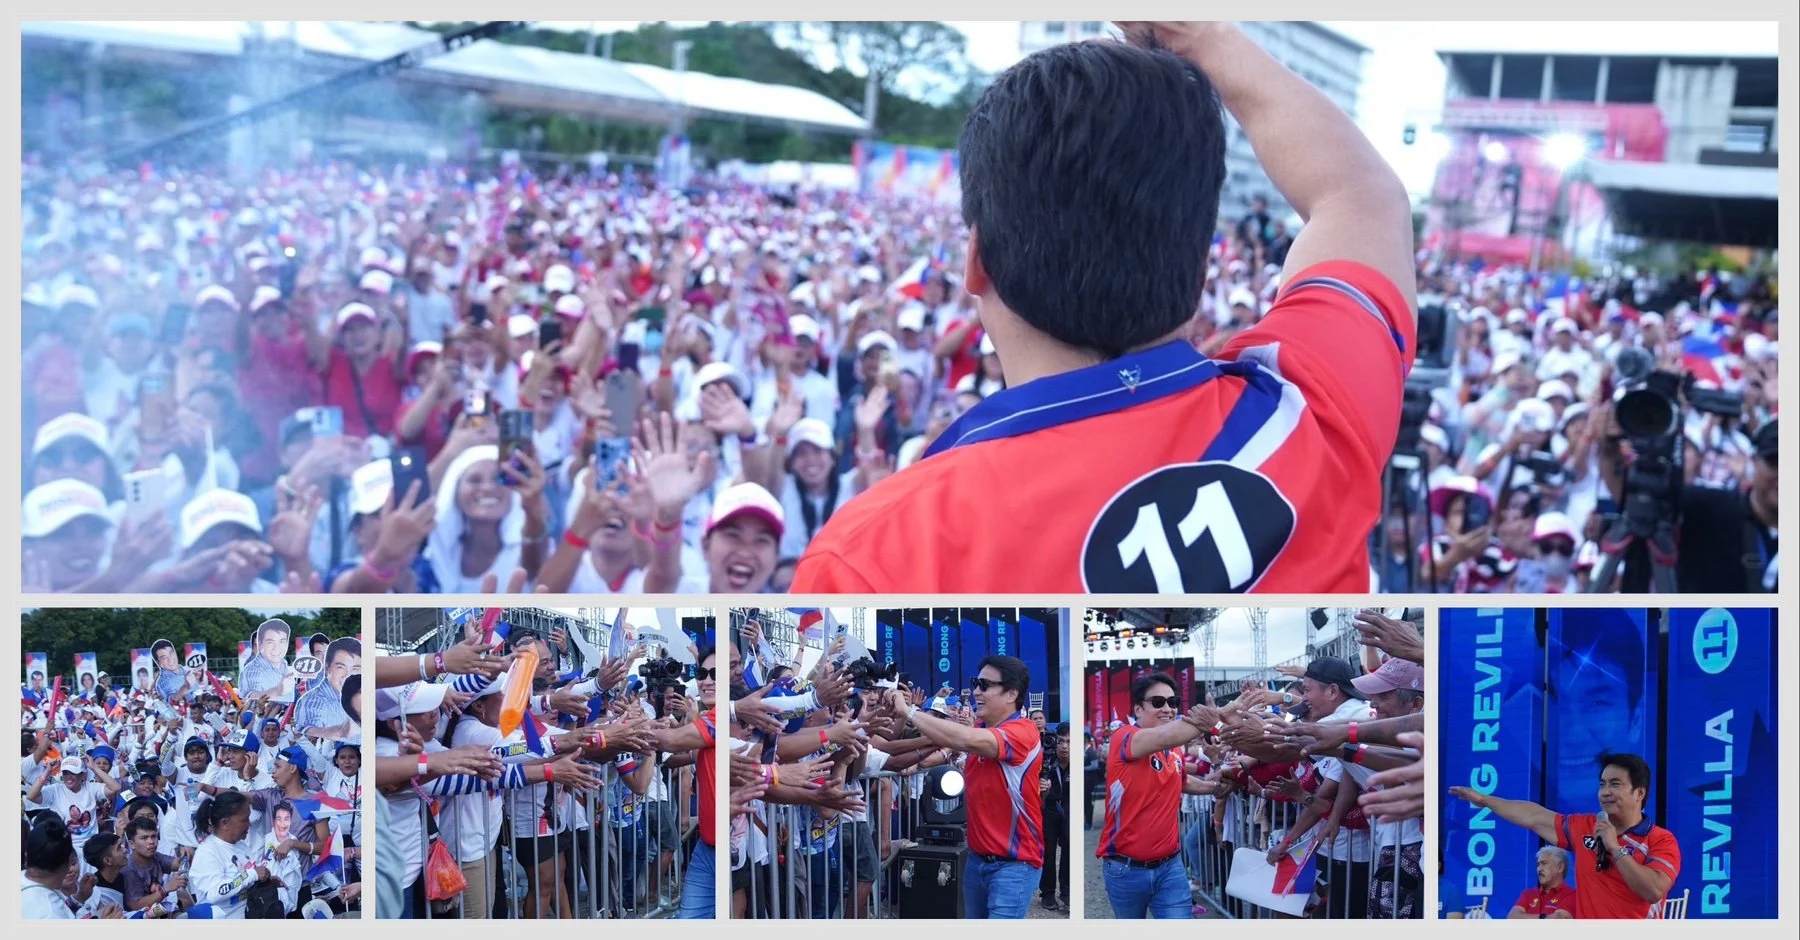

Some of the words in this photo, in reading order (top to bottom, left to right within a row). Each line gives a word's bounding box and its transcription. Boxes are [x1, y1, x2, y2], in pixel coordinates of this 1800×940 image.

[1117, 480, 1253, 593] 11
[885, 640, 893, 664] ONG
[940, 625, 949, 656] BONG
[1703, 619, 1728, 660] 11
[295, 658, 318, 673] #11
[1467, 763, 1498, 895] BONG
[1701, 709, 1734, 914] REVILLA
